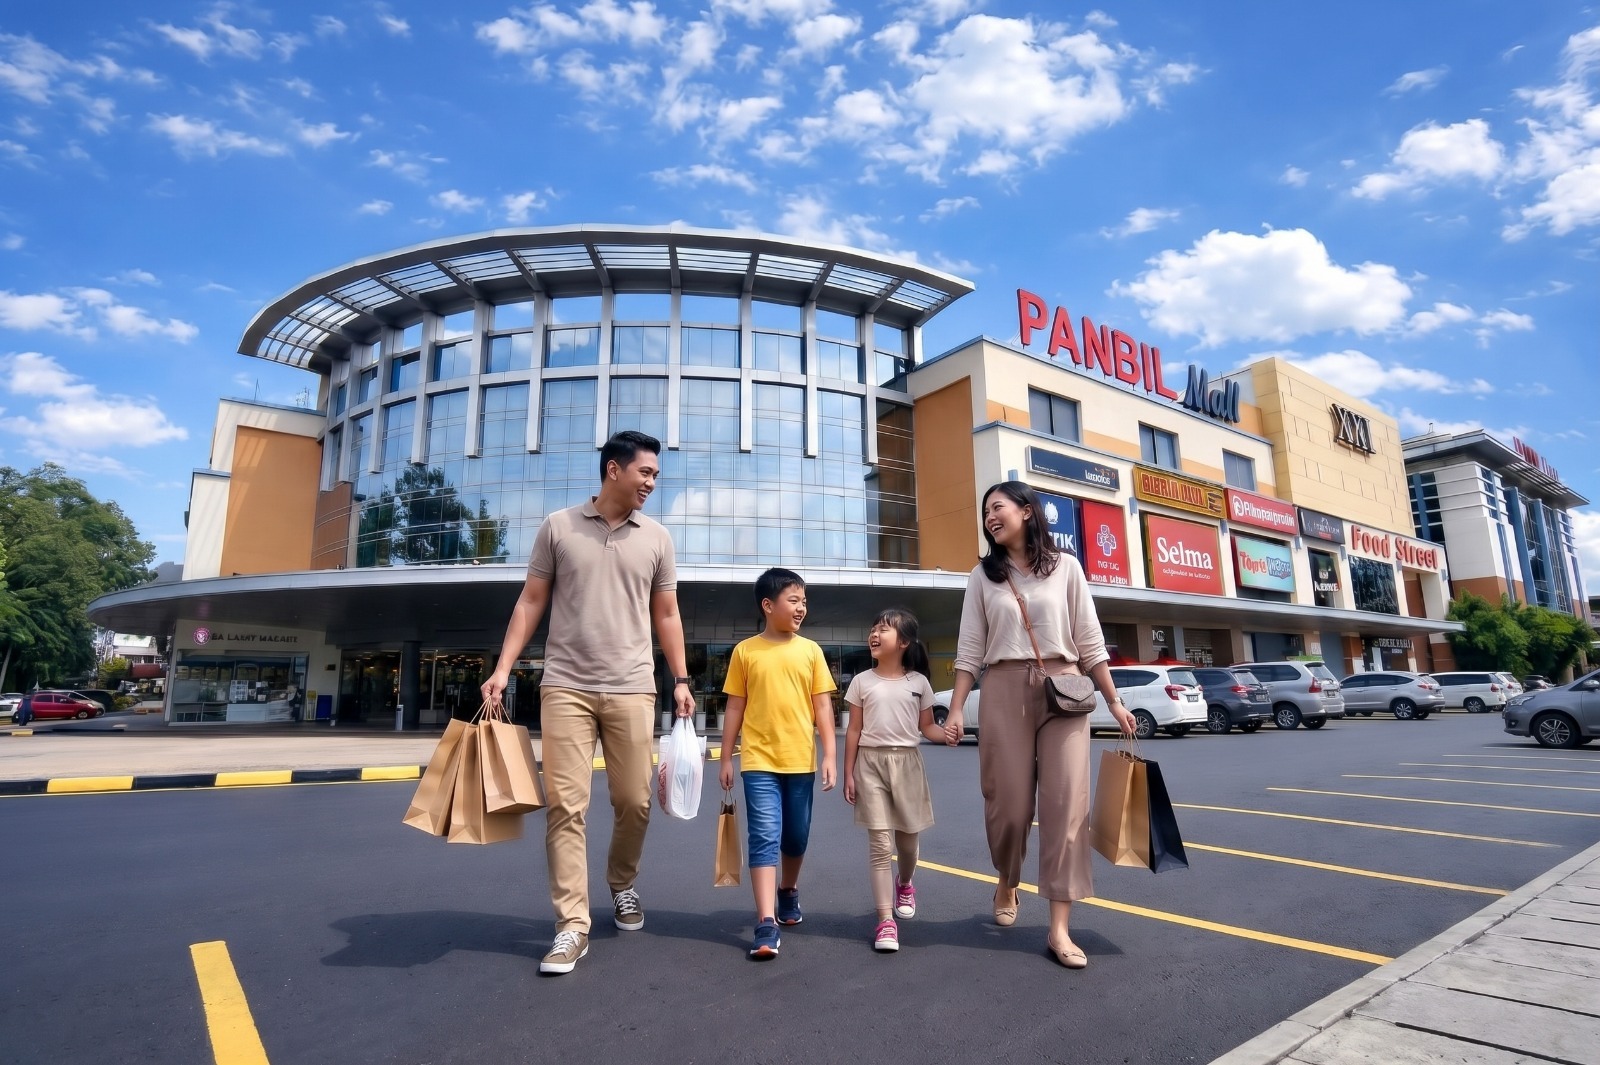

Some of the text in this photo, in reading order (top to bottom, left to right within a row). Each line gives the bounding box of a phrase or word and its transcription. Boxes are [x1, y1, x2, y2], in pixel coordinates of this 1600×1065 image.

[1017, 288, 1241, 424] PANBIL Mall
[1047, 531, 1077, 552] TIK
[1156, 536, 1214, 571] Selma
[1351, 524, 1391, 559] Food
[1395, 536, 1438, 570] Street
